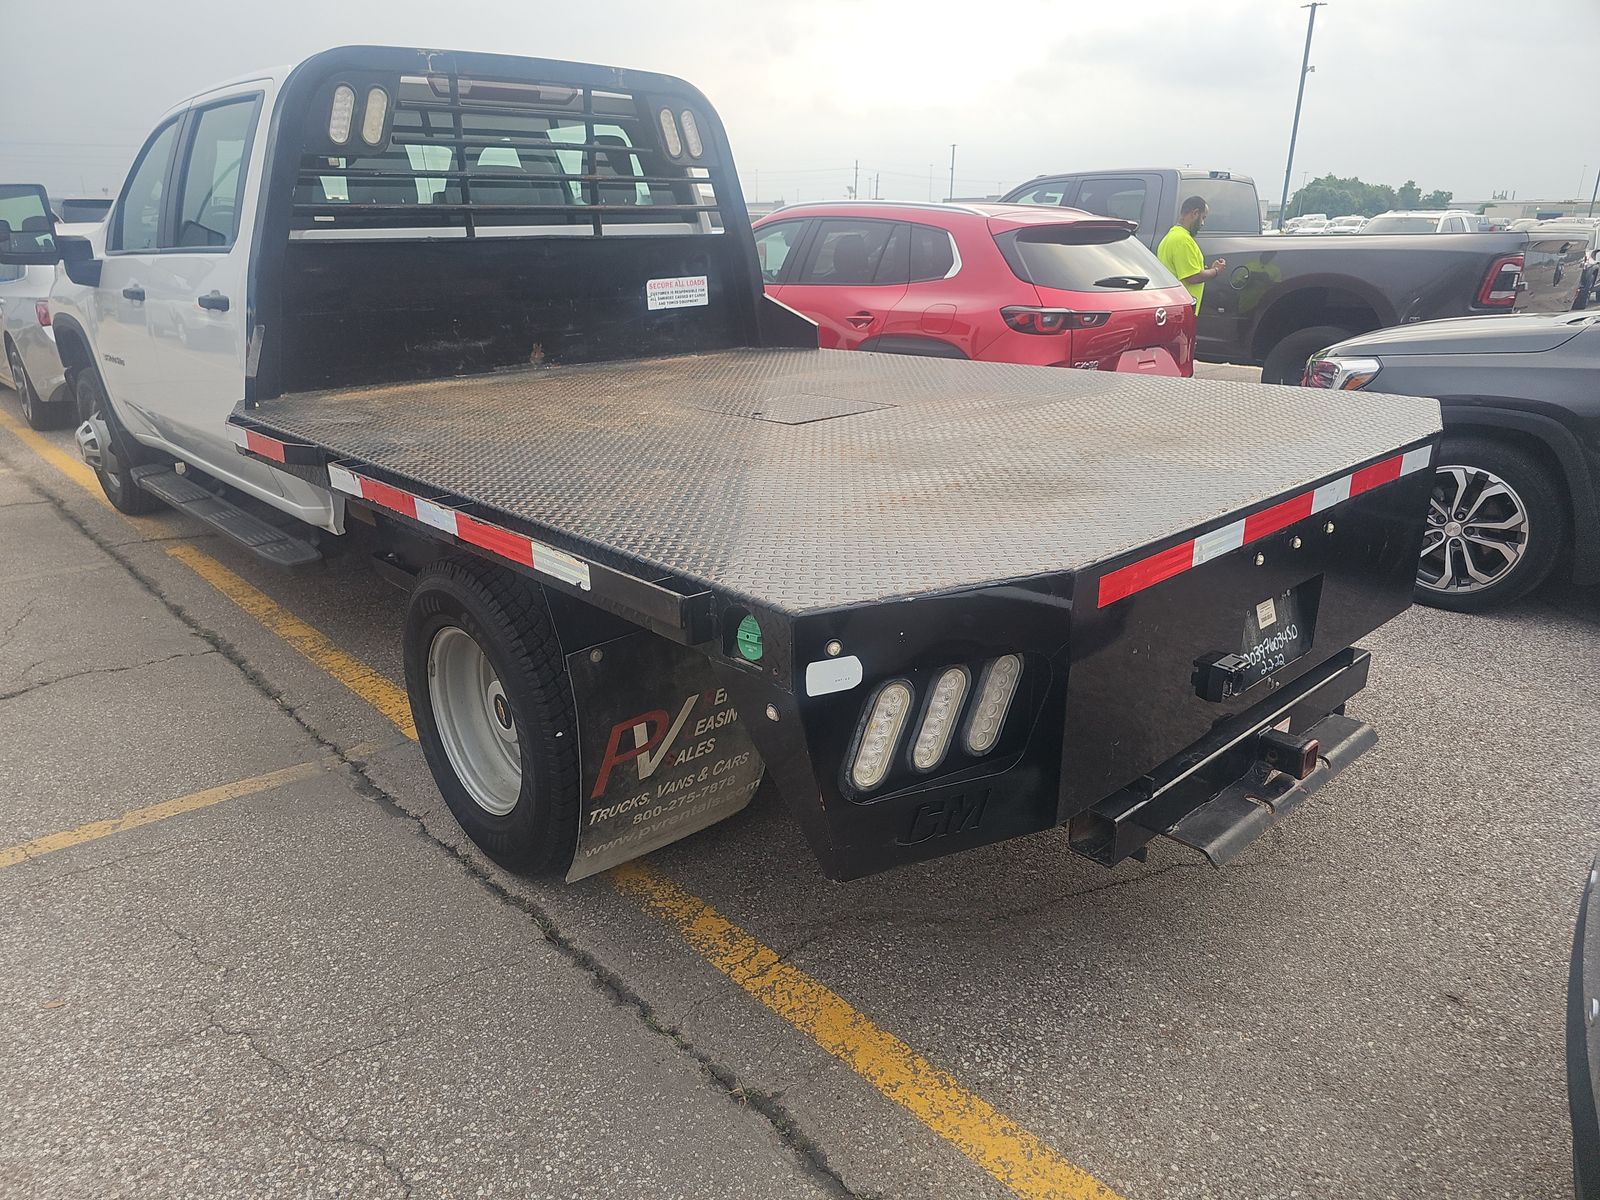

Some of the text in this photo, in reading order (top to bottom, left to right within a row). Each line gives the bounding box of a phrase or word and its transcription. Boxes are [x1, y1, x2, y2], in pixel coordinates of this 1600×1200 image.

[648, 279, 705, 290] SECURE ALL LOADS
[656, 774, 695, 799] VANS
[697, 766, 709, 783] &
[712, 752, 750, 777] CARS
[585, 779, 761, 858] www.pvrentals.com
[632, 775, 736, 826] 800-275-7878
